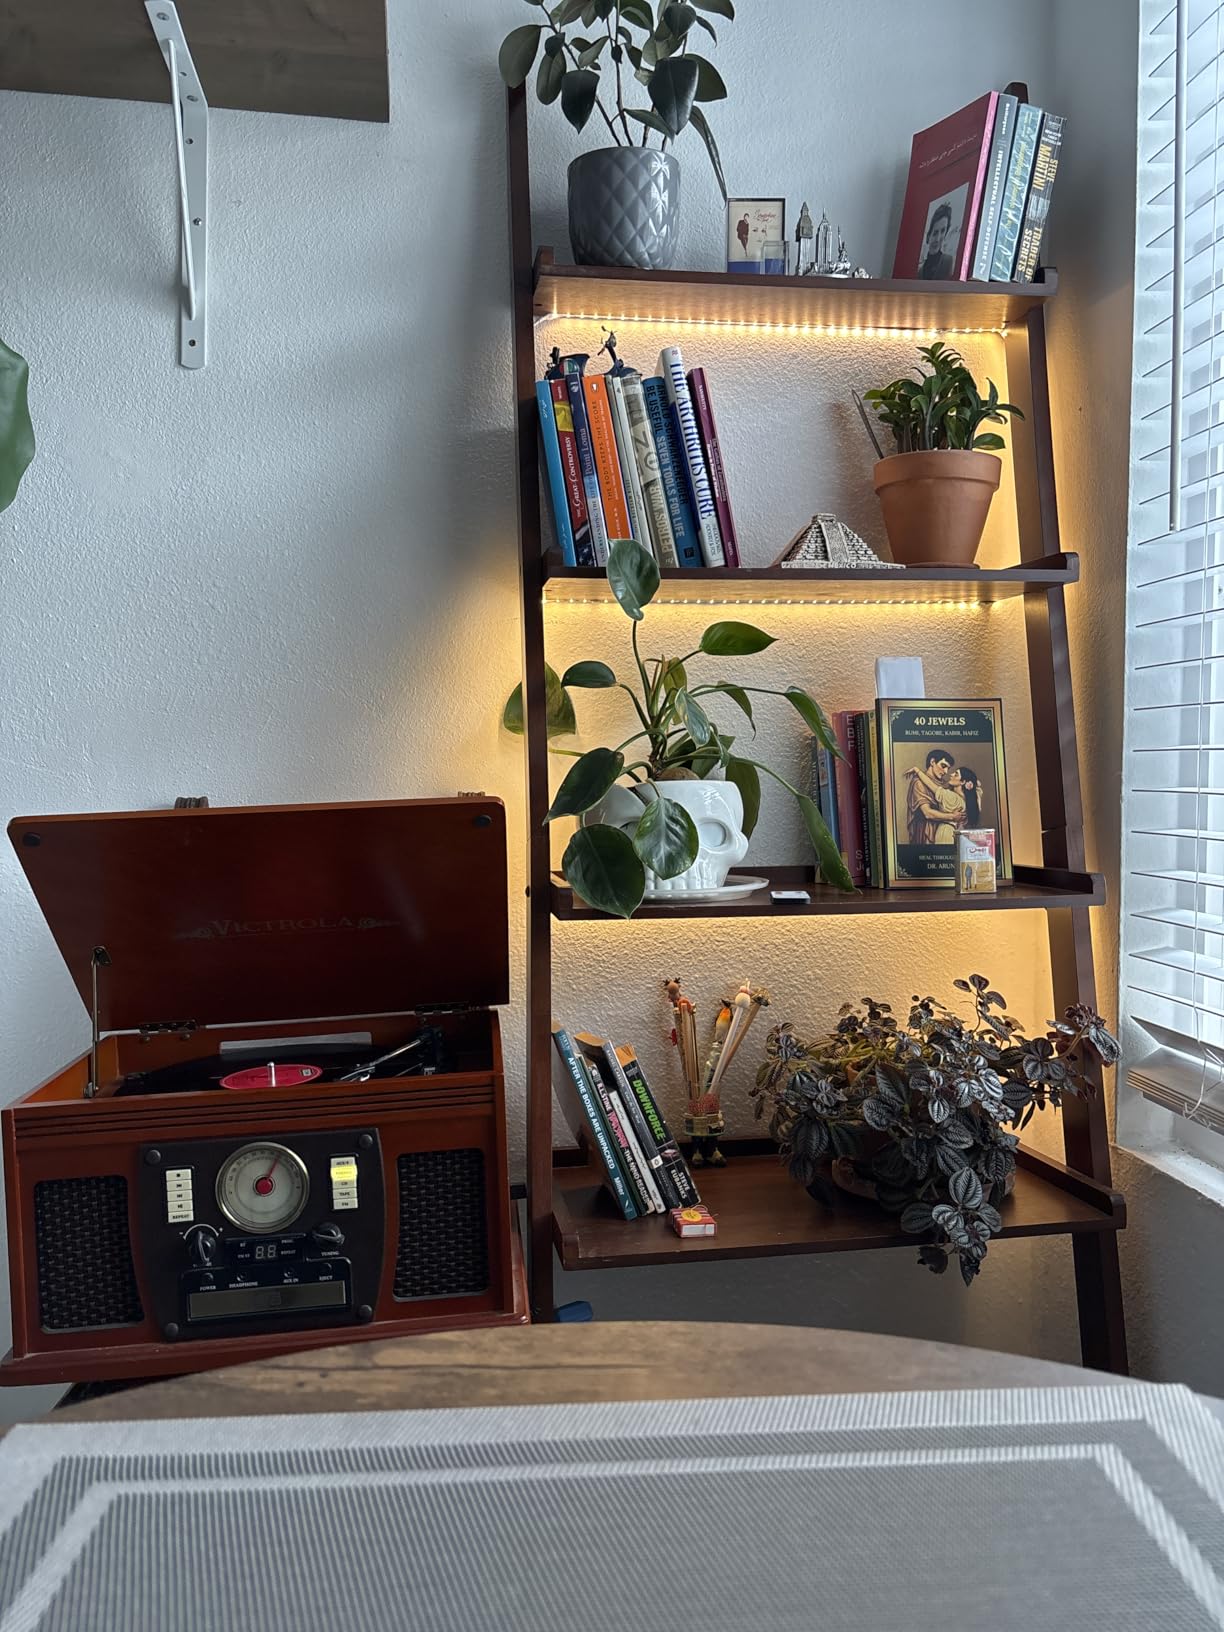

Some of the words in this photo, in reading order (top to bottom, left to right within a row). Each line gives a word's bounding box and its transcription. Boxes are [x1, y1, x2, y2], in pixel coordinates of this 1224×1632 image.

[991, 150, 1003, 205] INTELLECTUAL
[1033, 144, 1052, 191] MARTINI
[1047, 159, 1058, 183] STEVE
[1018, 228, 1032, 272] SECRETS
[1027, 227, 1042, 267] TRADER
[1025, 268, 1033, 281] OF
[646, 386, 656, 399] BE
[670, 363, 687, 393] THE
[649, 400, 660, 434] USEFUL
[580, 428, 589, 451] Loma
[656, 385, 667, 420] ARNOLD
[665, 422, 688, 504] SCHWARZENEGGER
[656, 436, 670, 465] SEVEN
[677, 397, 705, 476] ARTHRITIS
[584, 453, 592, 475] Point
[661, 466, 676, 495] TOOLS
[649, 486, 664, 511] WAR
[669, 498, 680, 515] FOR
[695, 479, 714, 520] CURE
[594, 513, 605, 562] UNDERSTANDING
[655, 511, 673, 554] PETROS'
[672, 517, 685, 538] LIFE
[914, 716, 926, 726] 40
[928, 716, 966, 726] JEWELS
[212, 917, 354, 936] VICTROLA
[633, 1079, 666, 1139] DOWNFORCE
[568, 1057, 581, 1082] AFTER
[577, 1080, 587, 1094] THE
[582, 1094, 596, 1118] BOXES
[591, 1118, 601, 1133] ARE
[597, 1131, 615, 1169] UNPACKED
[613, 1176, 624, 1196] Miller
[624, 1149, 633, 1163] THE
[628, 1162, 640, 1180] MIND
[670, 1169, 687, 1199] EUBANKS
[679, 1171, 690, 1190] STEVE
